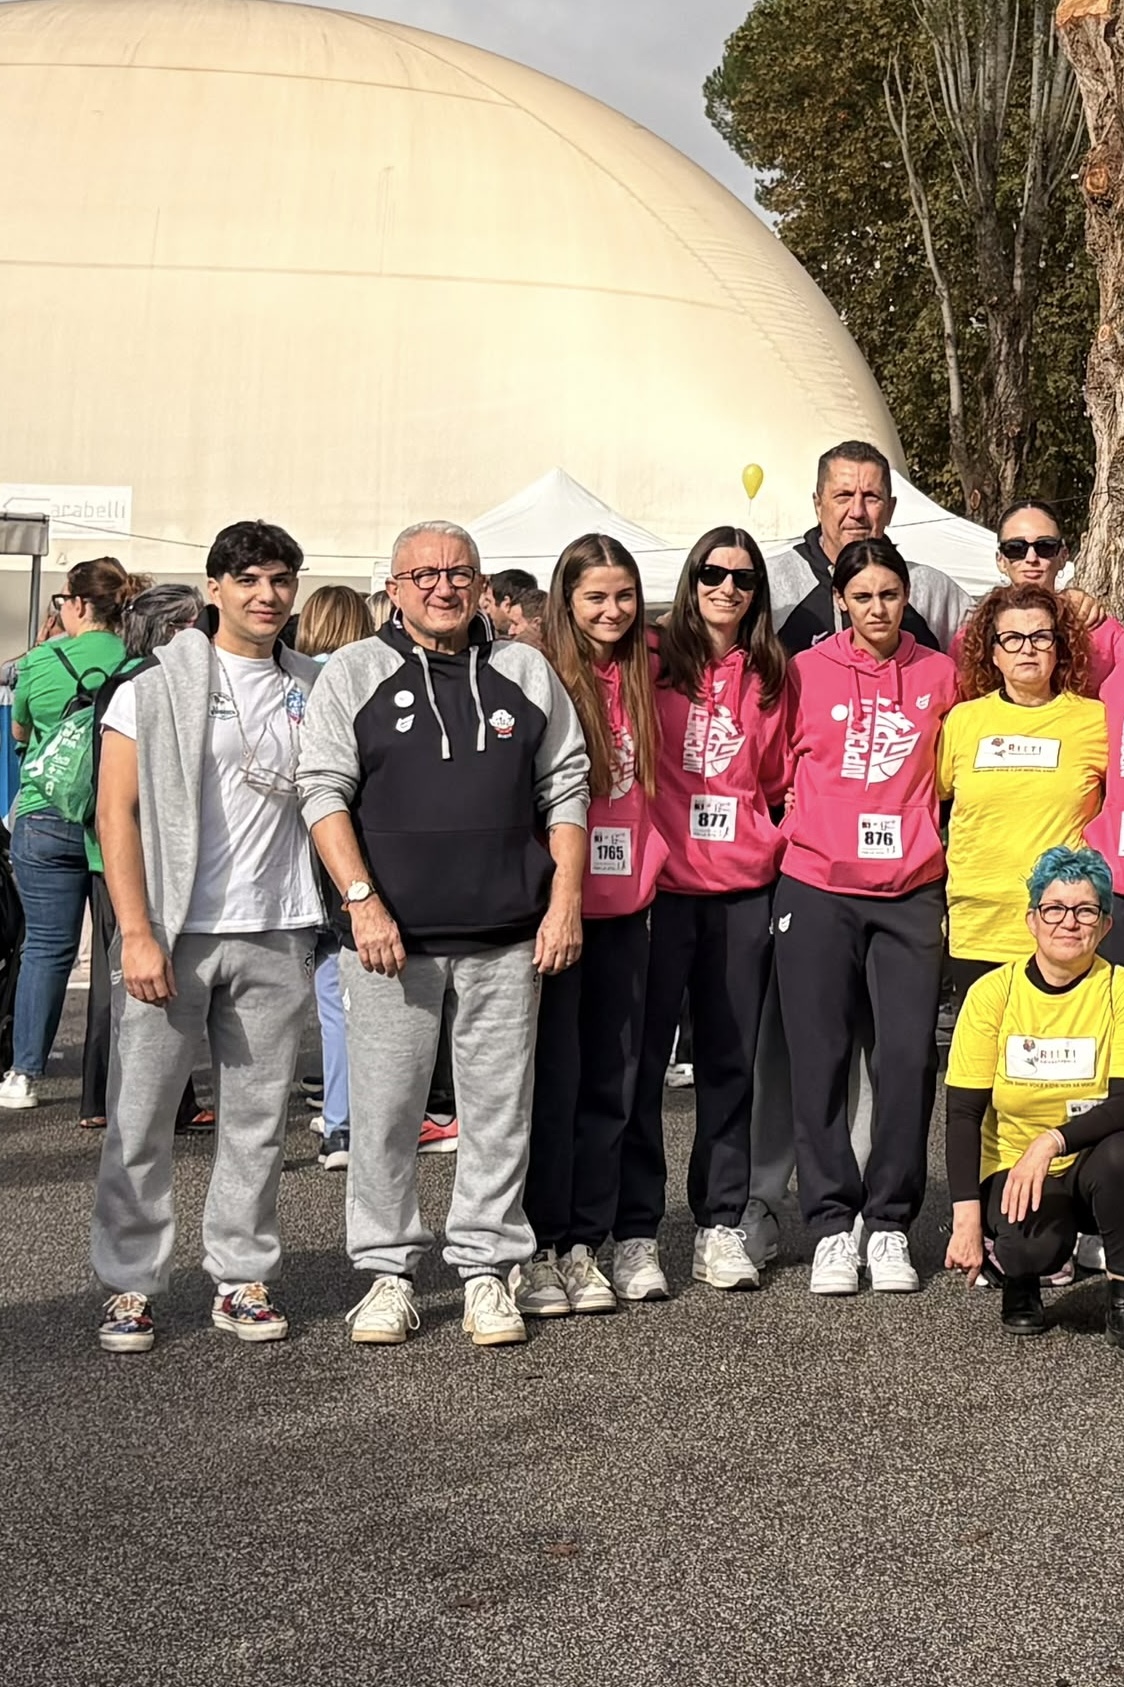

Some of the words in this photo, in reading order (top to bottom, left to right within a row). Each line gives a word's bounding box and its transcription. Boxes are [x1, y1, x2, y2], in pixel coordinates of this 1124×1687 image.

[698, 813, 728, 828] 877
[864, 831, 893, 846] 876
[597, 845, 624, 860] 1765
